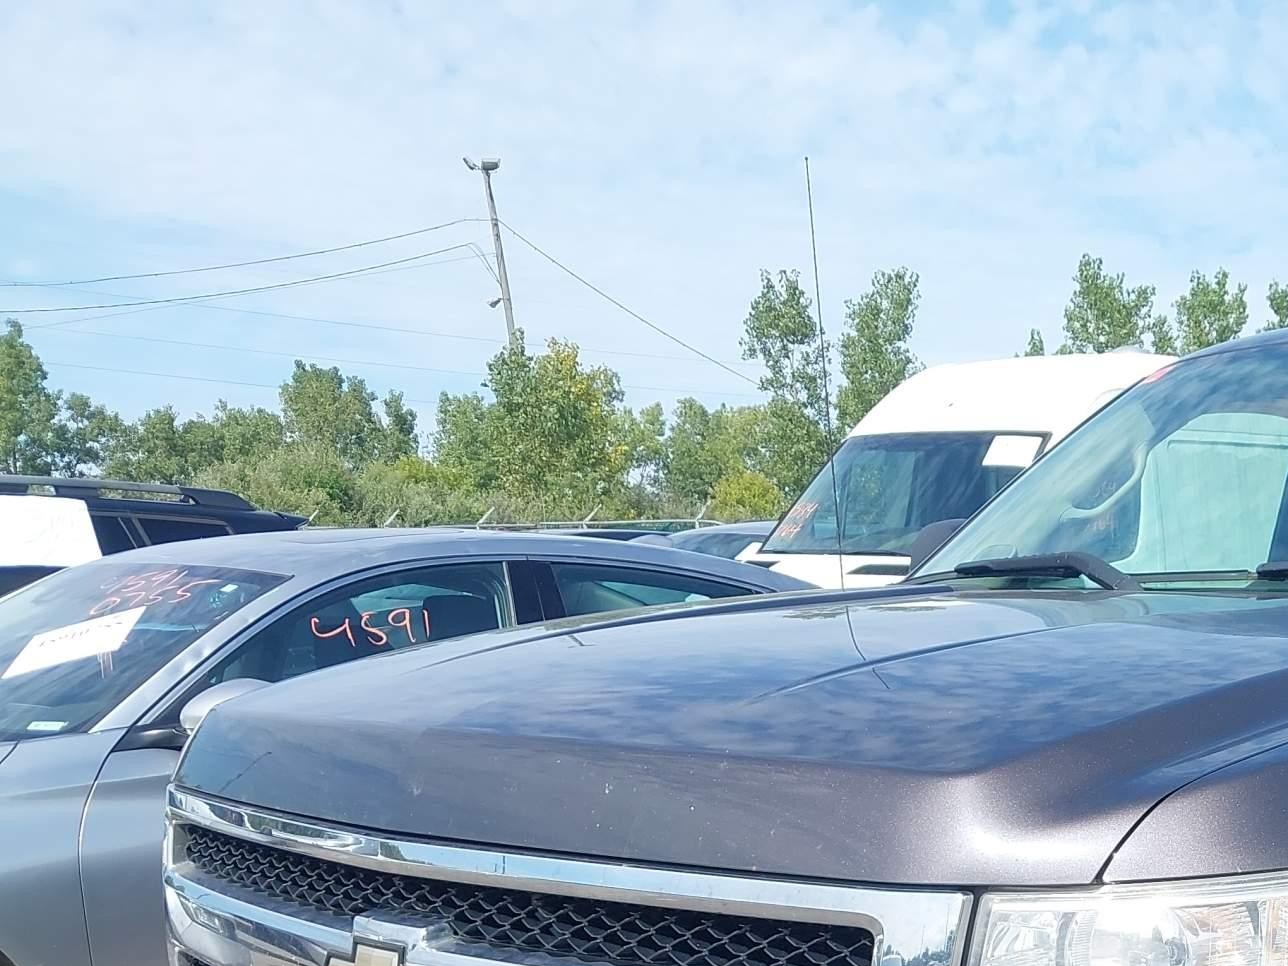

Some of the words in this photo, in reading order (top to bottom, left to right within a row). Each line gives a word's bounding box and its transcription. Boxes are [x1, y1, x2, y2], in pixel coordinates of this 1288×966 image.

[89, 578, 224, 616] 0755
[100, 568, 189, 595] 4591
[310, 607, 431, 648] 4591
